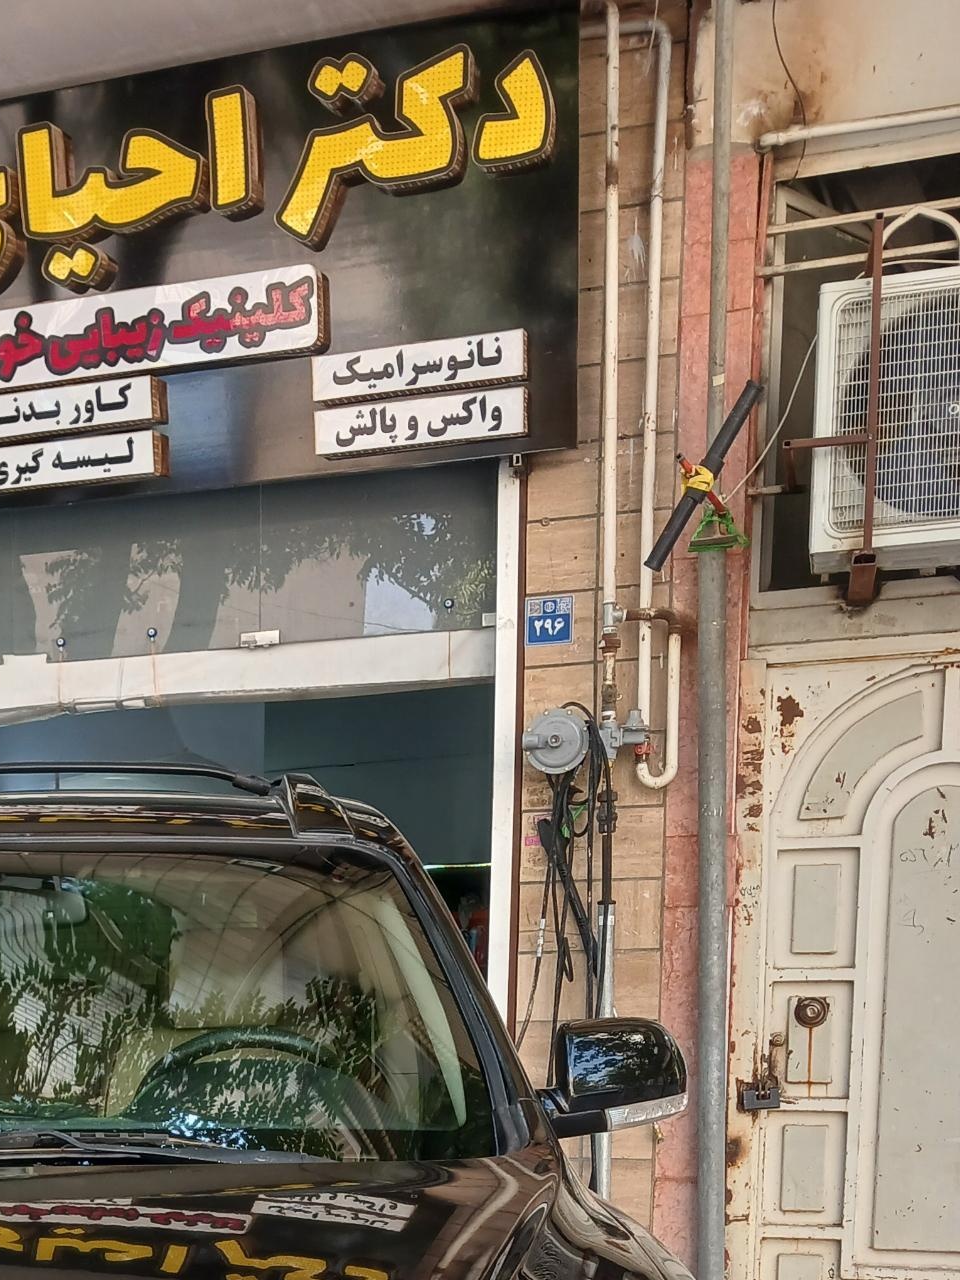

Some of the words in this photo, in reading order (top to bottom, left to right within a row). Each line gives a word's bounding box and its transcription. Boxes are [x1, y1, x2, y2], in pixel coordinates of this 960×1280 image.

[276, 44, 554, 249] دکتر
[168, 276, 312, 353] کلینیک
[45, 307, 166, 376] زیبایی
[69, 382, 132, 425] کاور
[427, 394, 503, 437] واکس
[335, 406, 398, 448] پالش
[404, 414, 419, 441] و
[51, 436, 135, 473] لیسه
[534, 617, 565, 637] ۲۹۶
